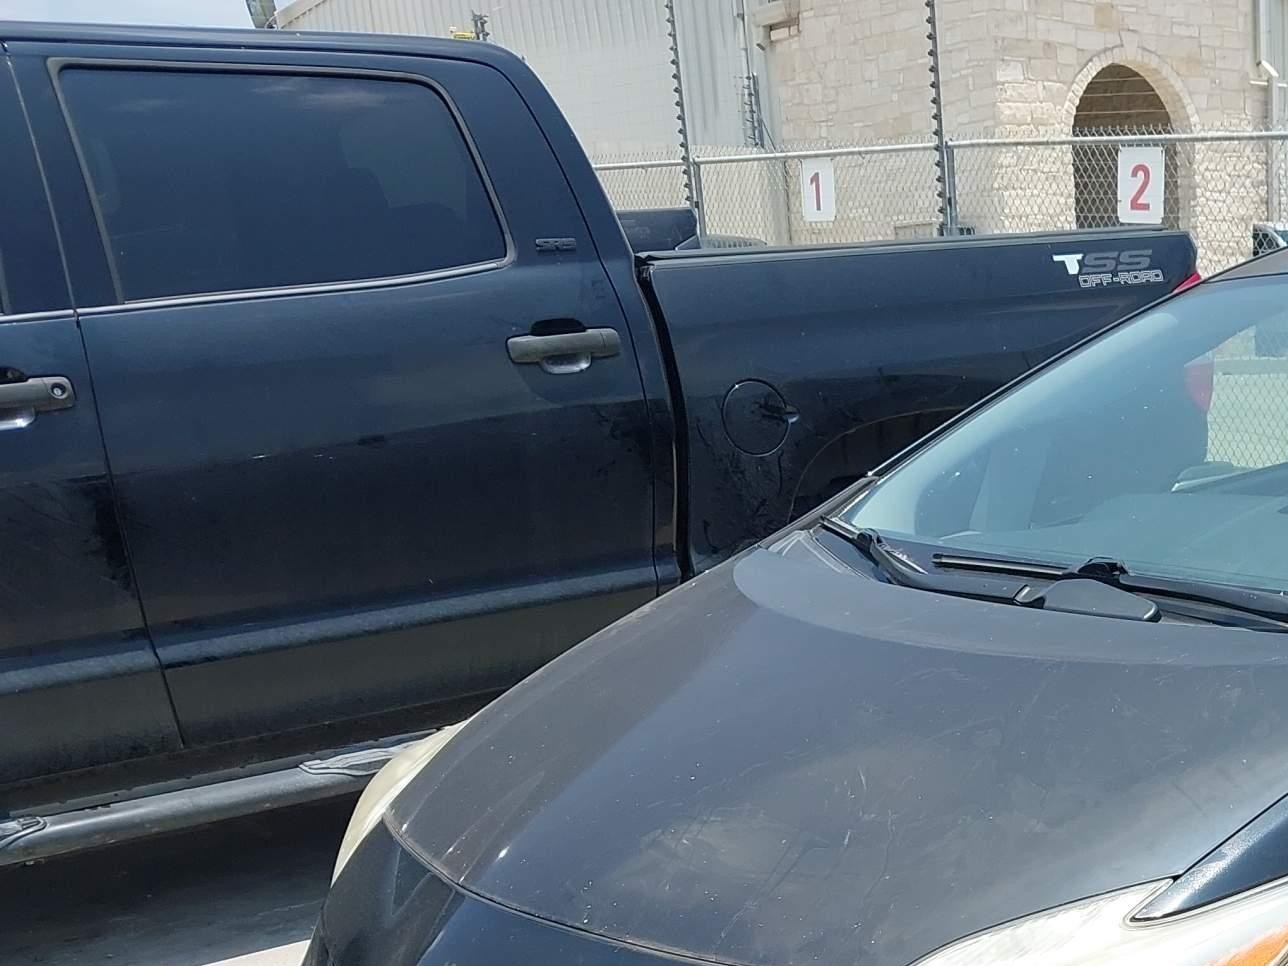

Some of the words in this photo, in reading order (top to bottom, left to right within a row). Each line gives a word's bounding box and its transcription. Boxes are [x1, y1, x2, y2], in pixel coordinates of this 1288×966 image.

[809, 171, 822, 212] 1
[1129, 163, 1151, 212] 2
[1051, 249, 1153, 275] TSS
[1078, 269, 1164, 288] OFF-ROAD
